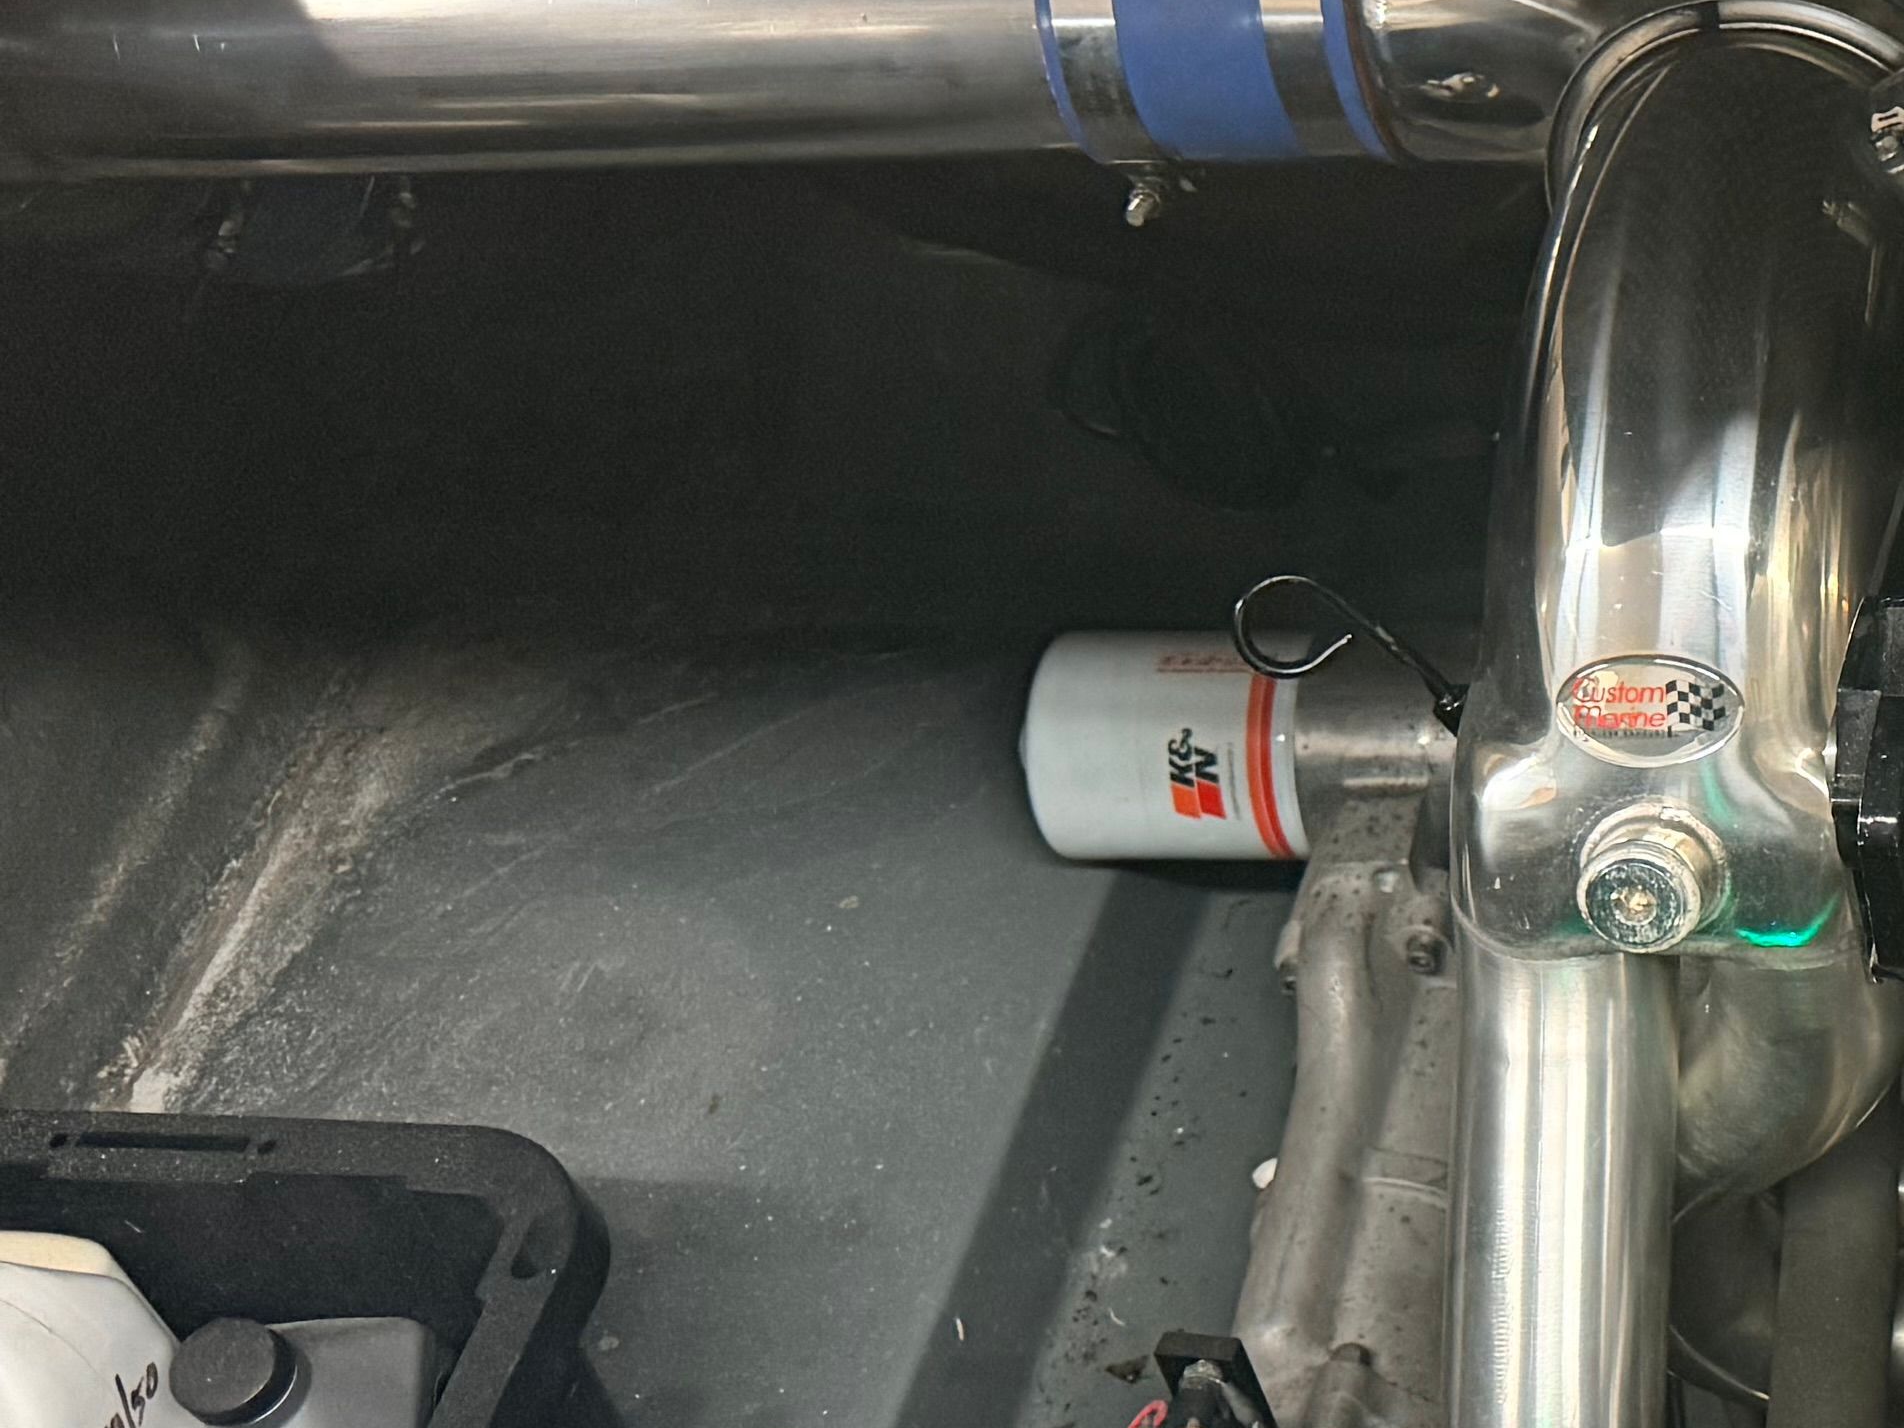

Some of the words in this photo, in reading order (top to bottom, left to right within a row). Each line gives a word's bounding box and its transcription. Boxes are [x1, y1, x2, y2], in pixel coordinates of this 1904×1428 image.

[1572, 676, 1665, 704] Custom
[1573, 705, 1666, 730] Marine
[1168, 727, 1220, 785] K&N
